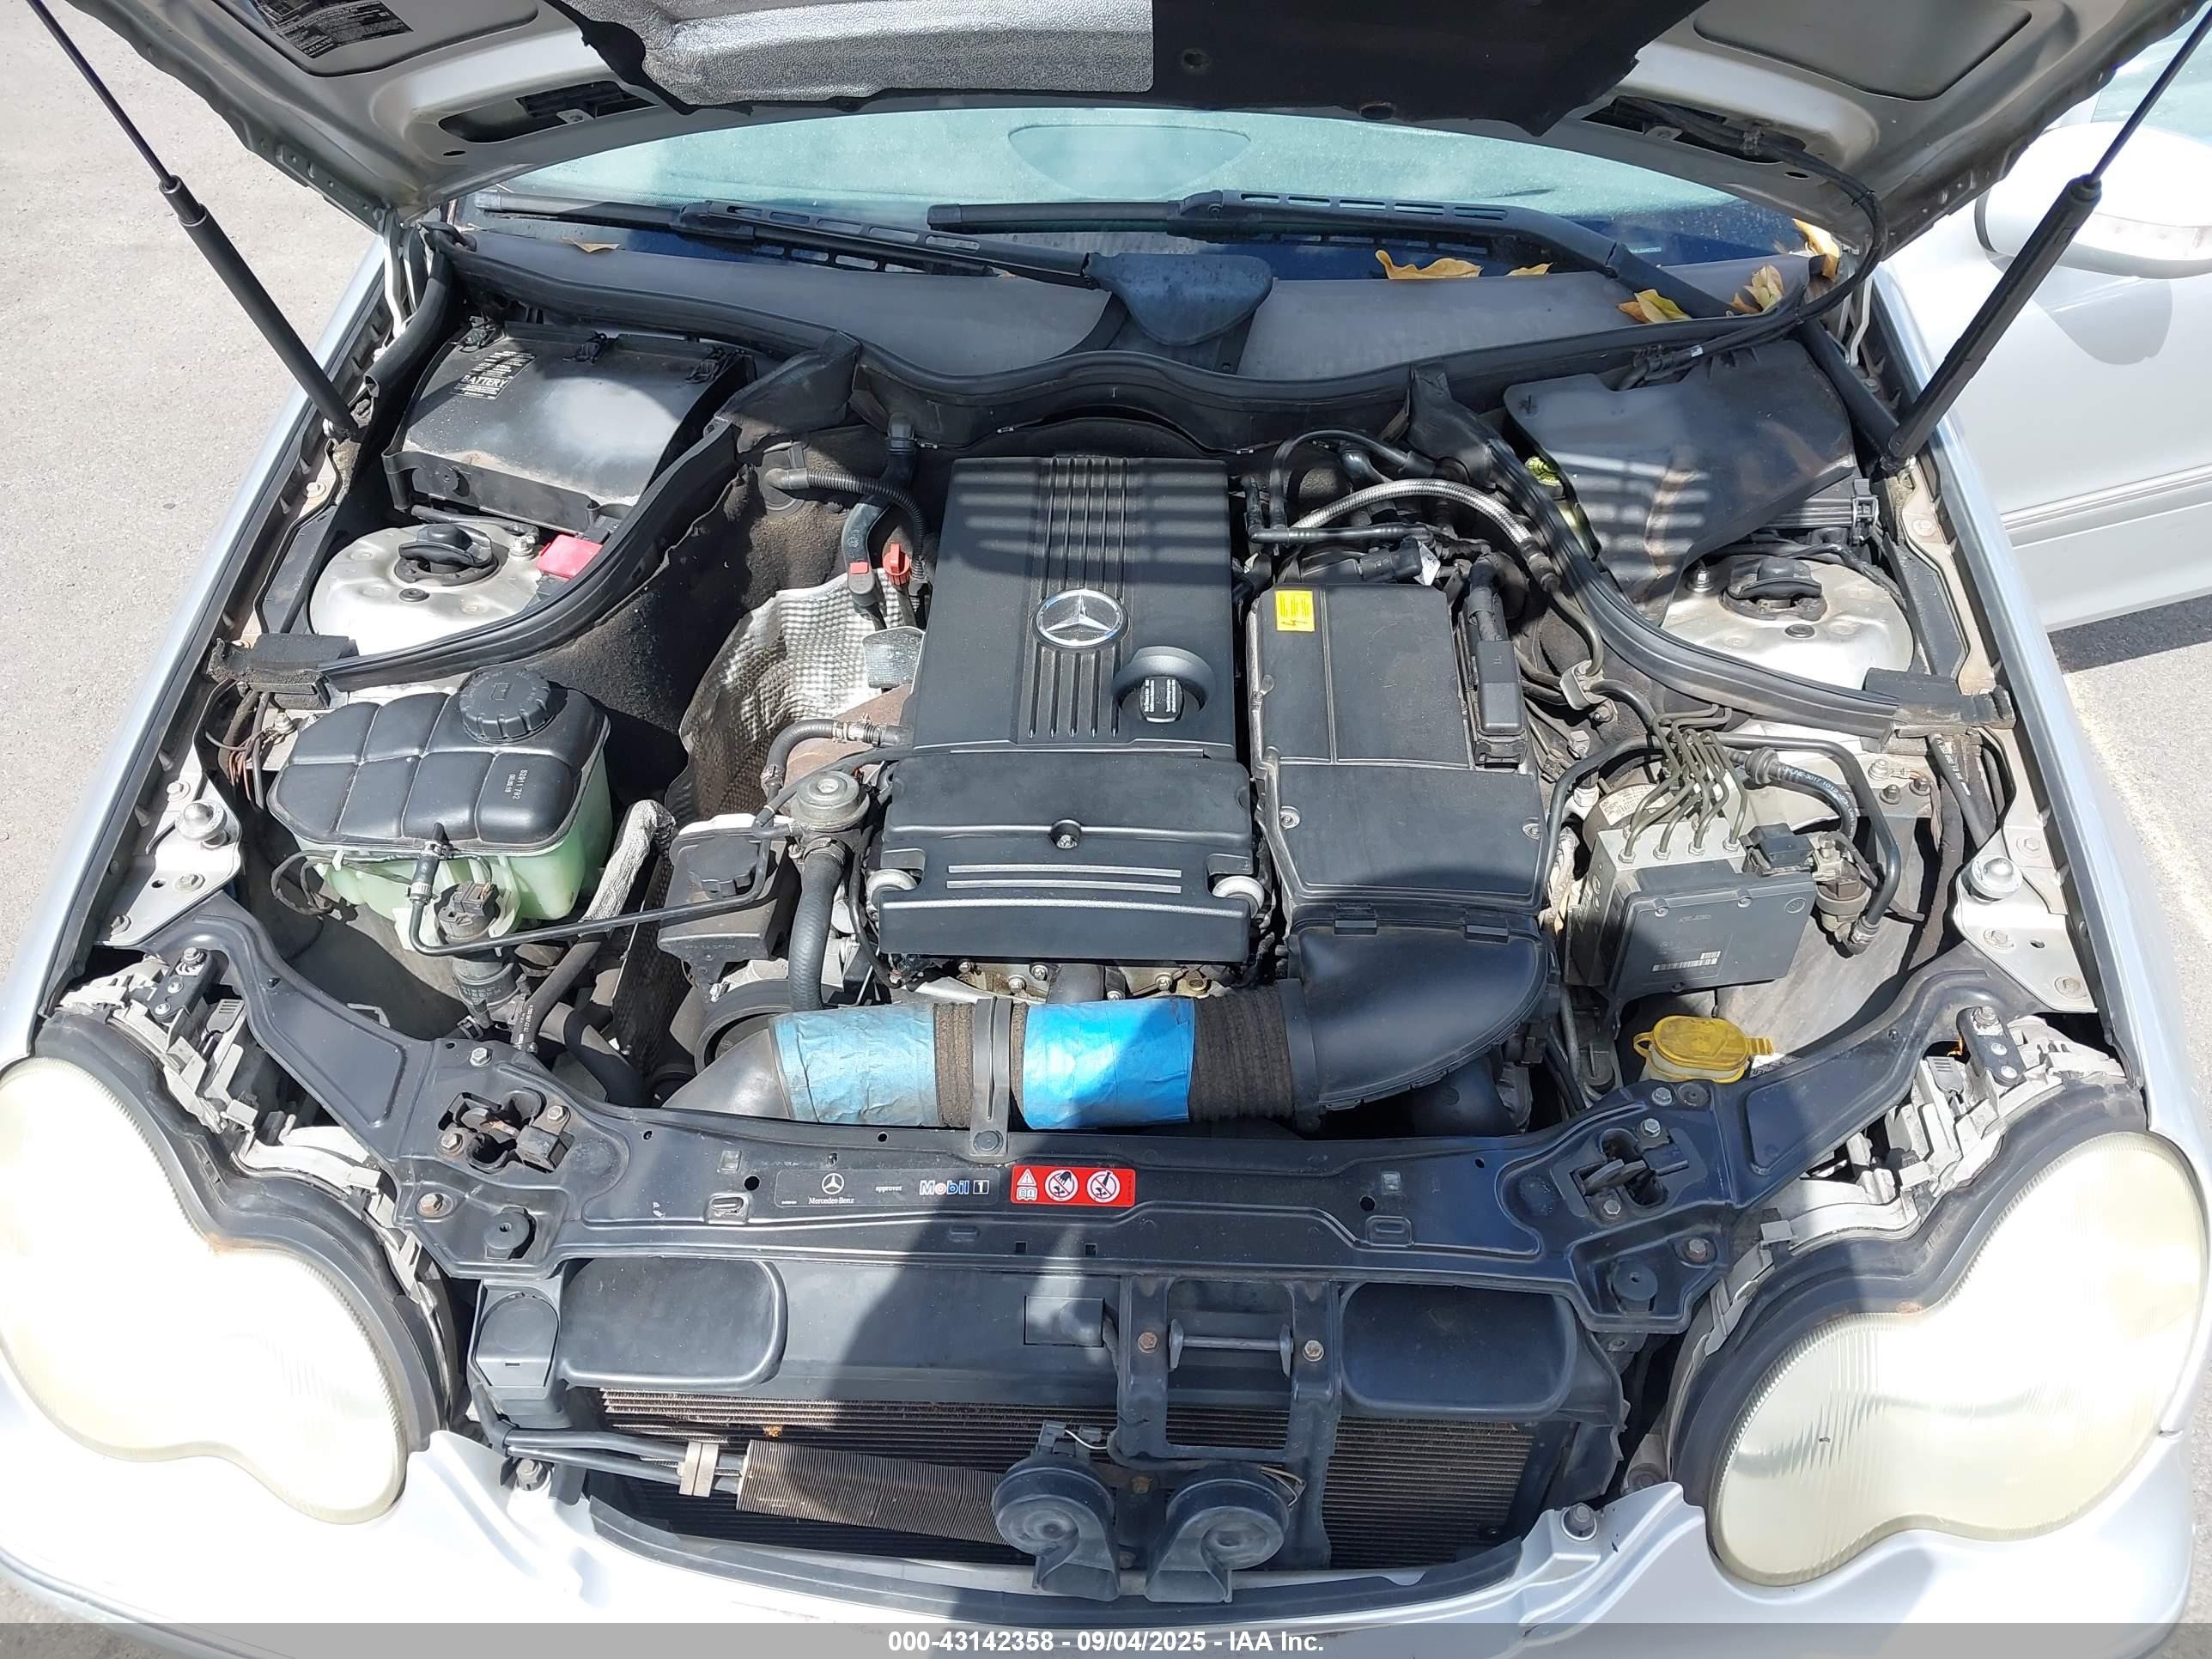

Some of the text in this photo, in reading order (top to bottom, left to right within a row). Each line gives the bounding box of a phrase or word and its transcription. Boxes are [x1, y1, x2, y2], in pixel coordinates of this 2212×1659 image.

[304, 37, 333, 54] CATALYST
[461, 374, 509, 388] BATTERY
[919, 1179, 970, 1196] Mobil
[808, 1196, 855, 1205] Mercedes-Benz
